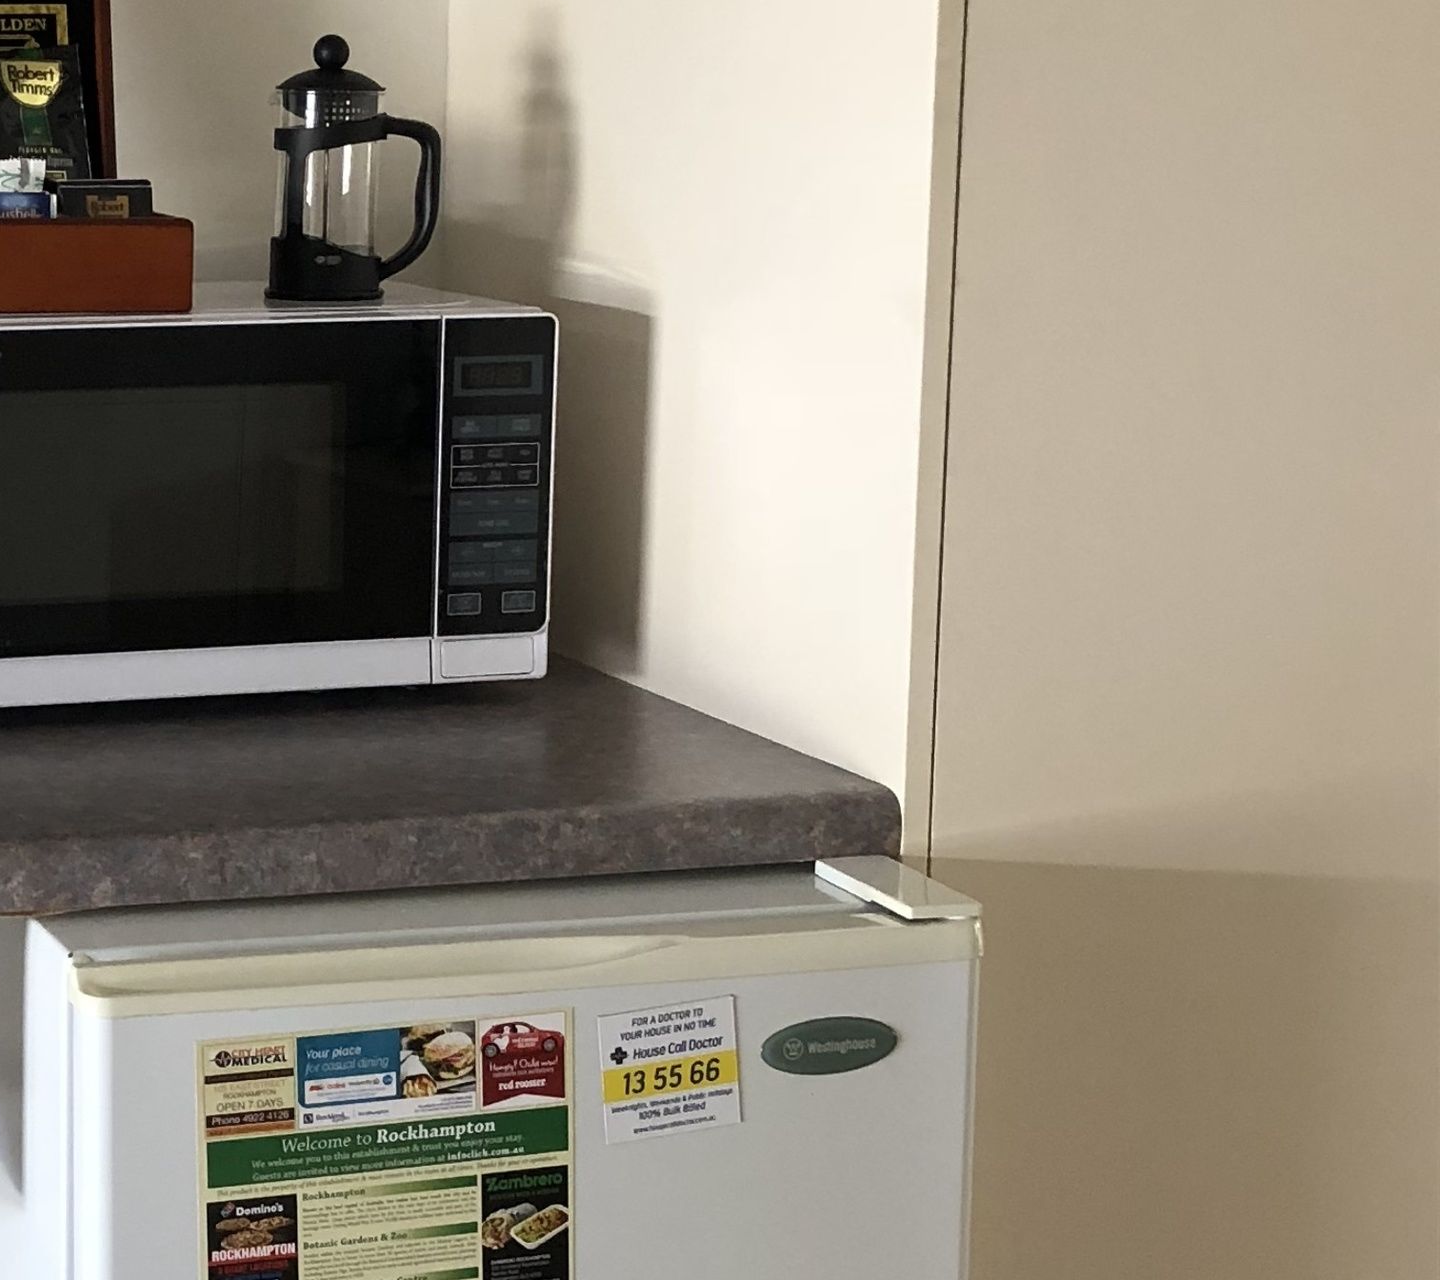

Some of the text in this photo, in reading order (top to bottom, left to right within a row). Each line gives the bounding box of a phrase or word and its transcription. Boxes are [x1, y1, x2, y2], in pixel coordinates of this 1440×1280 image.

[7, 64, 54, 81] Robert
[632, 1008, 704, 1026] FOR A DOCTOR TO
[620, 1018, 716, 1040] YOUR HOUSE IN NO TIME
[306, 1046, 362, 1059] Your place
[633, 1036, 723, 1060] House Call Doctor
[807, 1038, 876, 1054] Westinghouse
[231, 1054, 287, 1067] MEDICAL
[305, 1062, 319, 1077] for
[322, 1059, 355, 1071] casual
[358, 1057, 389, 1068] dining
[498, 1077, 546, 1090] red rooster
[623, 1058, 720, 1095] 13 55 66
[216, 1098, 283, 1112] OPEN 7 DAYS
[638, 1101, 706, 1120] 100% Bulk Billed
[212, 1116, 240, 1126] Phone
[243, 1113, 264, 1122] 4922
[282, 1121, 496, 1153] Welcome to Rockhampton
[252, 1159, 266, 1168] We
[268, 1156, 304, 1166] welcome
[306, 1156, 321, 1165] you
[323, 1154, 332, 1162] to
[334, 1151, 350, 1160] this
[352, 1146, 410, 1158] establishment
[412, 1145, 420, 1153] &
[422, 1142, 442, 1151] trust
[444, 1140, 459, 1149] you
[461, 1138, 483, 1148] enjoy
[485, 1136, 504, 1145] your
[252, 1172, 282, 1182] Guests
[298, 1167, 328, 1177] invited
[340, 1164, 360, 1173] view
[362, 1162, 384, 1170] more
[385, 1156, 436, 1168] information
[448, 1146, 524, 1161] infoclick.com.au
[486, 1172, 563, 1192] Zambrero
[302, 1188, 365, 1201] Rockhampton
[236, 1202, 284, 1216] Domino's
[303, 1240, 338, 1250] Botanic
[340, 1236, 378, 1246] Gardens
[390, 1232, 407, 1240] Zoo
[212, 1242, 296, 1262] ROCKHAMPTON
